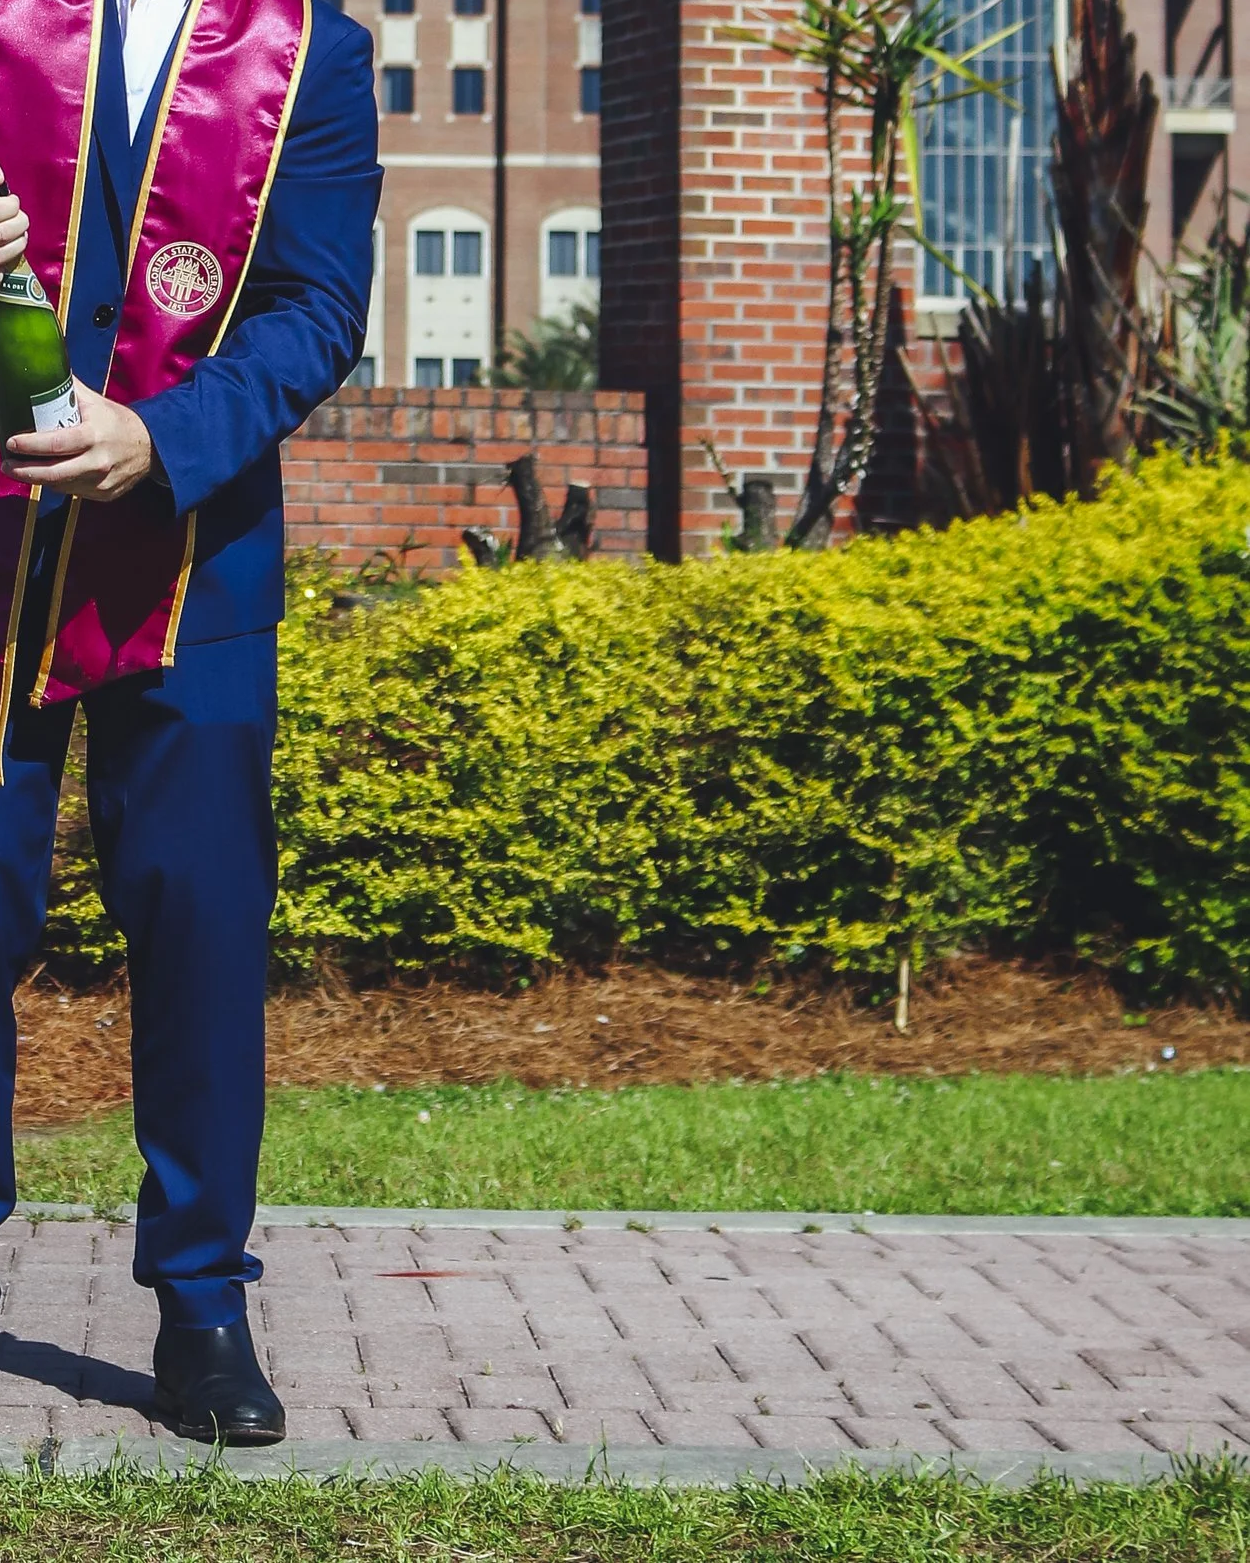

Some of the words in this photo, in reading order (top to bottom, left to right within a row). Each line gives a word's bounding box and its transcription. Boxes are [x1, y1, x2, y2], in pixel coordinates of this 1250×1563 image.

[151, 253, 170, 291] FLORIDA
[171, 246, 199, 256] STATE
[200, 253, 218, 306] UNIVERSITY
[168, 302, 186, 312] 1851
